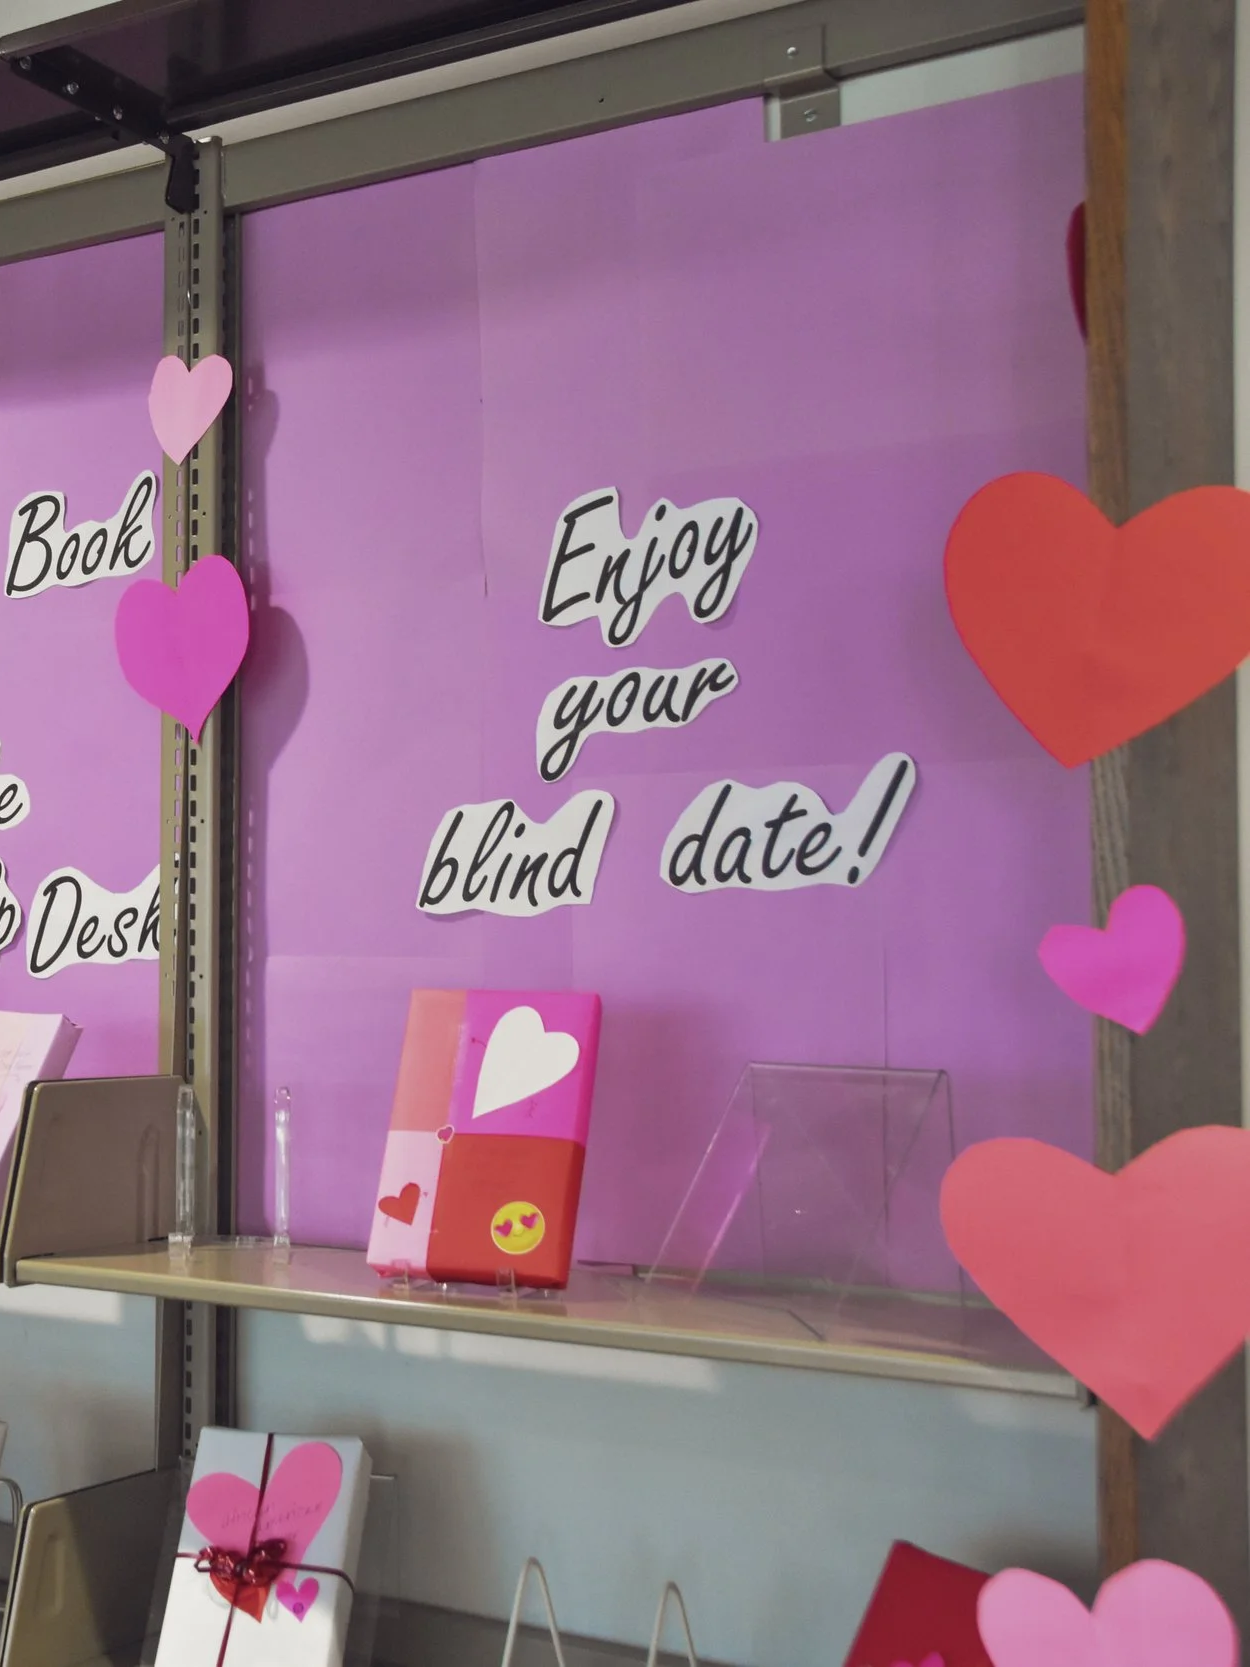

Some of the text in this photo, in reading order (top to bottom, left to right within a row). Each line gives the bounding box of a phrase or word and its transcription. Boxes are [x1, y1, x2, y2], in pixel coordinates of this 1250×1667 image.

[6, 475, 154, 597] Book
[541, 495, 754, 647] Enjoy
[540, 661, 735, 783] your
[418, 759, 909, 909] blind date!
